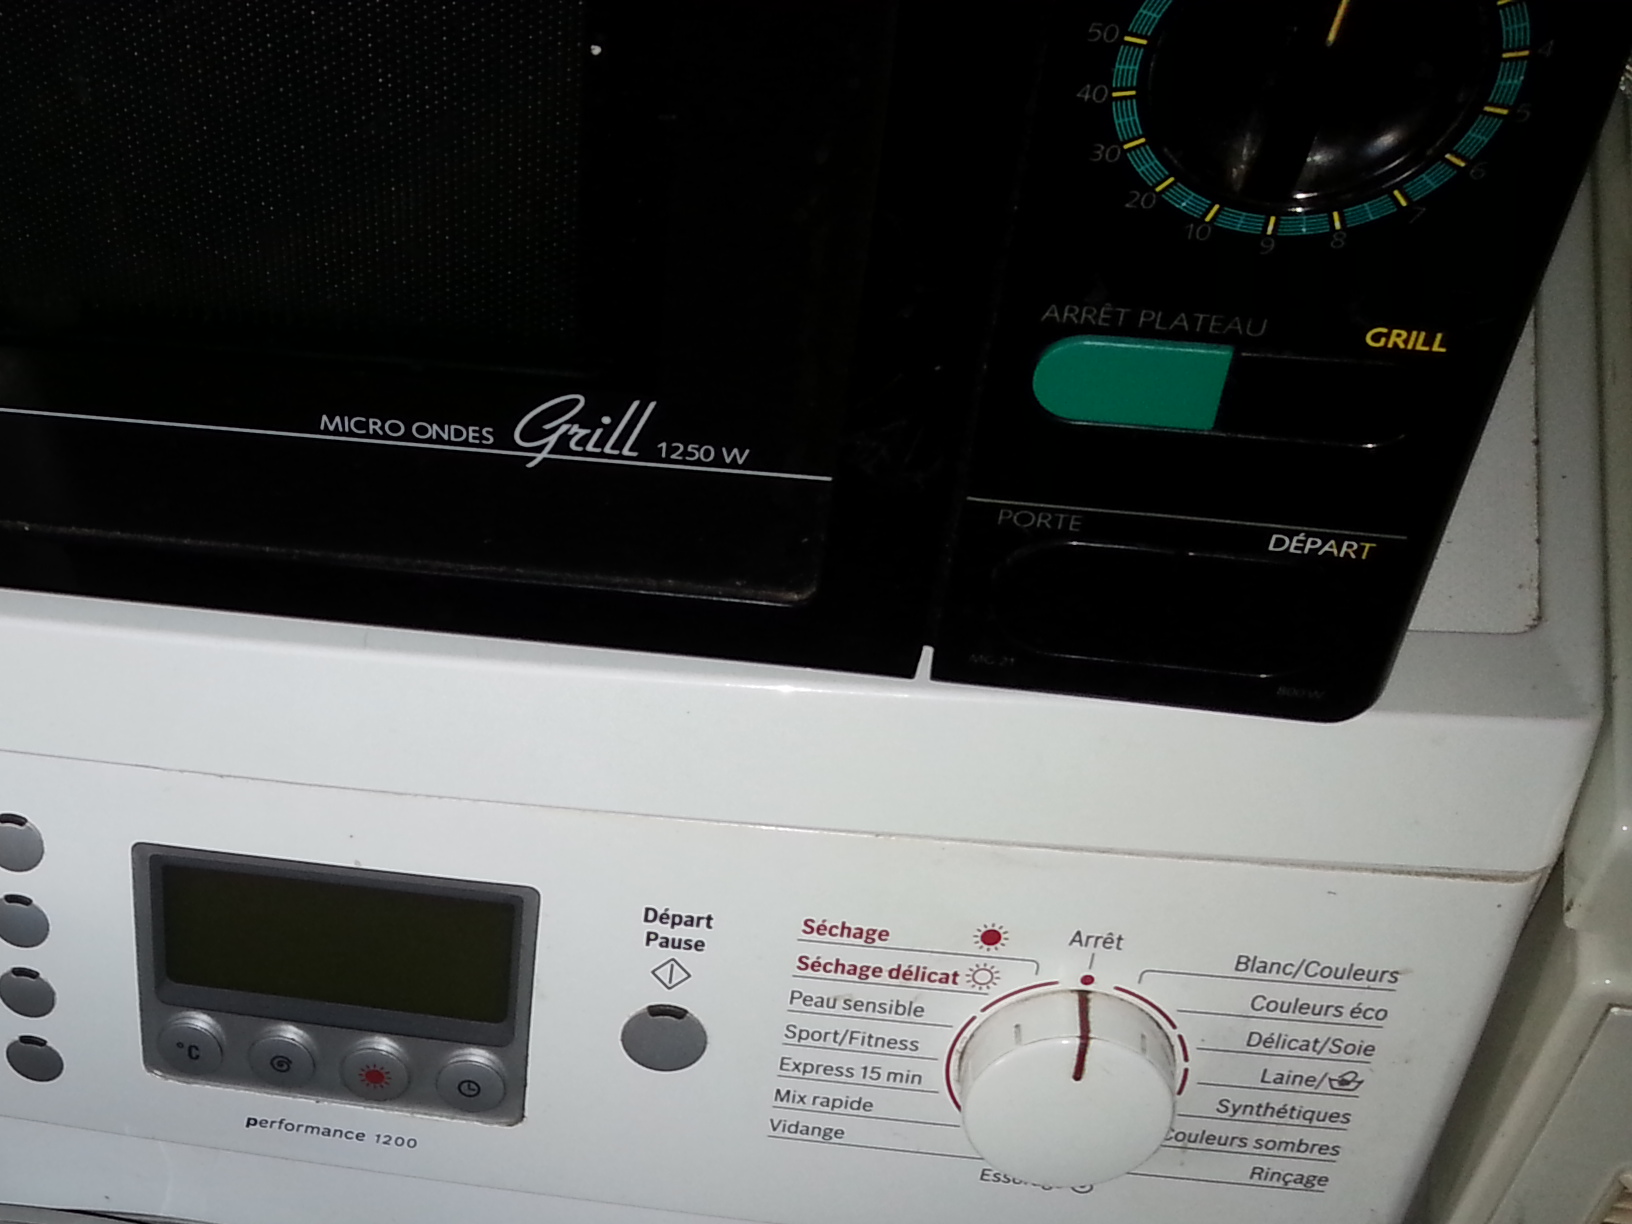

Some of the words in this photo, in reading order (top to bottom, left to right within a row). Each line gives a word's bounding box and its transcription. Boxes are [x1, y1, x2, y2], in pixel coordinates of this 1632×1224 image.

[1087, 22, 1119, 43] 50
[1538, 39, 1555, 57] 4
[1076, 84, 1109, 103] 40
[1515, 103, 1532, 122] 5
[1089, 143, 1121, 163] 30
[1469, 162, 1486, 180] 6
[1124, 189, 1156, 210] 20
[1409, 205, 1426, 224] 7
[1184, 222, 1211, 241] 10
[1331, 231, 1346, 249] 8
[1259, 236, 1276, 255] 9
[1041, 304, 1131, 328] ARRÊT
[1139, 309, 1268, 337] PLATEAU
[1365, 327, 1447, 352] GRILL
[319, 414, 405, 437] MICRO
[411, 421, 494, 445] ONDES
[513, 394, 657, 468] Grill
[656, 442, 715, 462] 1250
[722, 447, 751, 465] W
[997, 508, 1082, 532] PORTE
[1268, 533, 1376, 560] DÉPART
[642, 906, 714, 931] Départ
[801, 917, 890, 944] Séchage
[645, 930, 706, 954] Pause
[1069, 929, 1123, 952] Arrêt
[796, 955, 884, 980] Séchage
[890, 962, 960, 986] délicat
[1234, 954, 1401, 986] Blanc/Couleurs
[788, 990, 836, 1013] Peau
[840, 993, 925, 1017] sensible
[1250, 995, 1346, 1021] Couleurs
[1351, 1001, 1388, 1022] éco
[783, 1024, 920, 1052] Sport/Fitness
[1245, 1031, 1376, 1057] Délicat/Soie
[778, 1057, 856, 1079] Express
[861, 1064, 880, 1081] 15
[885, 1064, 923, 1086] min
[1260, 1067, 1326, 1090] Laine/
[773, 1087, 807, 1108] Mix
[811, 1093, 874, 1113] rapide
[1216, 1099, 1352, 1125] Synthétiques
[245, 1113, 366, 1143] performance
[374, 1133, 418, 1150] 1200
[768, 1119, 846, 1143] Vidange
[1253, 1138, 1341, 1157] sombres
[1249, 1166, 1329, 1189] Rinçage
